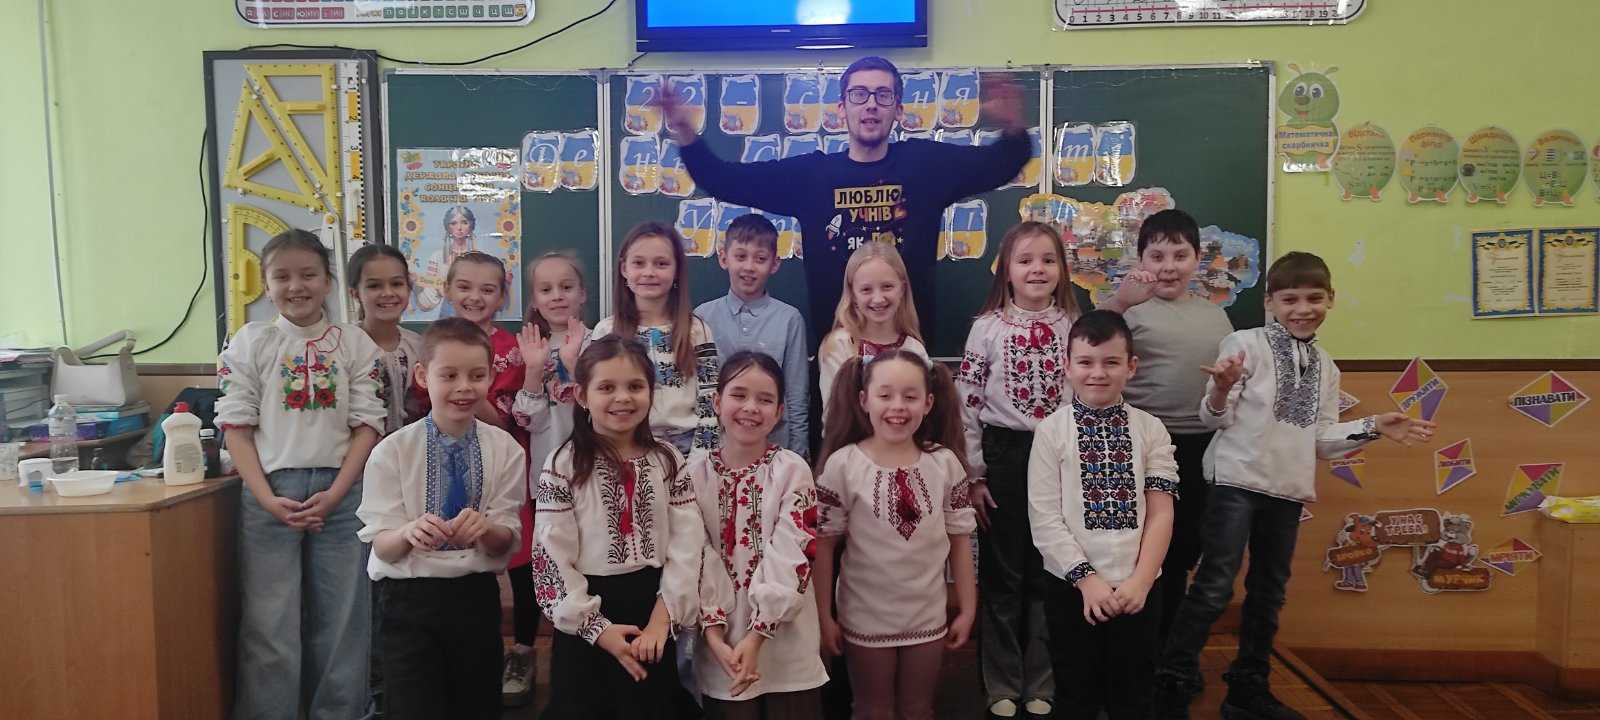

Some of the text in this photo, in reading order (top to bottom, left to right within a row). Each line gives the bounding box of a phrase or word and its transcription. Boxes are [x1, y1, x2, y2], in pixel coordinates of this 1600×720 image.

[1200, 11, 1210, 20] 10
[640, 85, 697, 112] 22
[799, 86, 971, 110] сня
[836, 188, 900, 205] ЛЮБЛЮ
[849, 205, 892, 223] УЧНІВ
[847, 236, 864, 250] ЯК
[1513, 391, 1576, 407] ПІЗНАВАТИ
